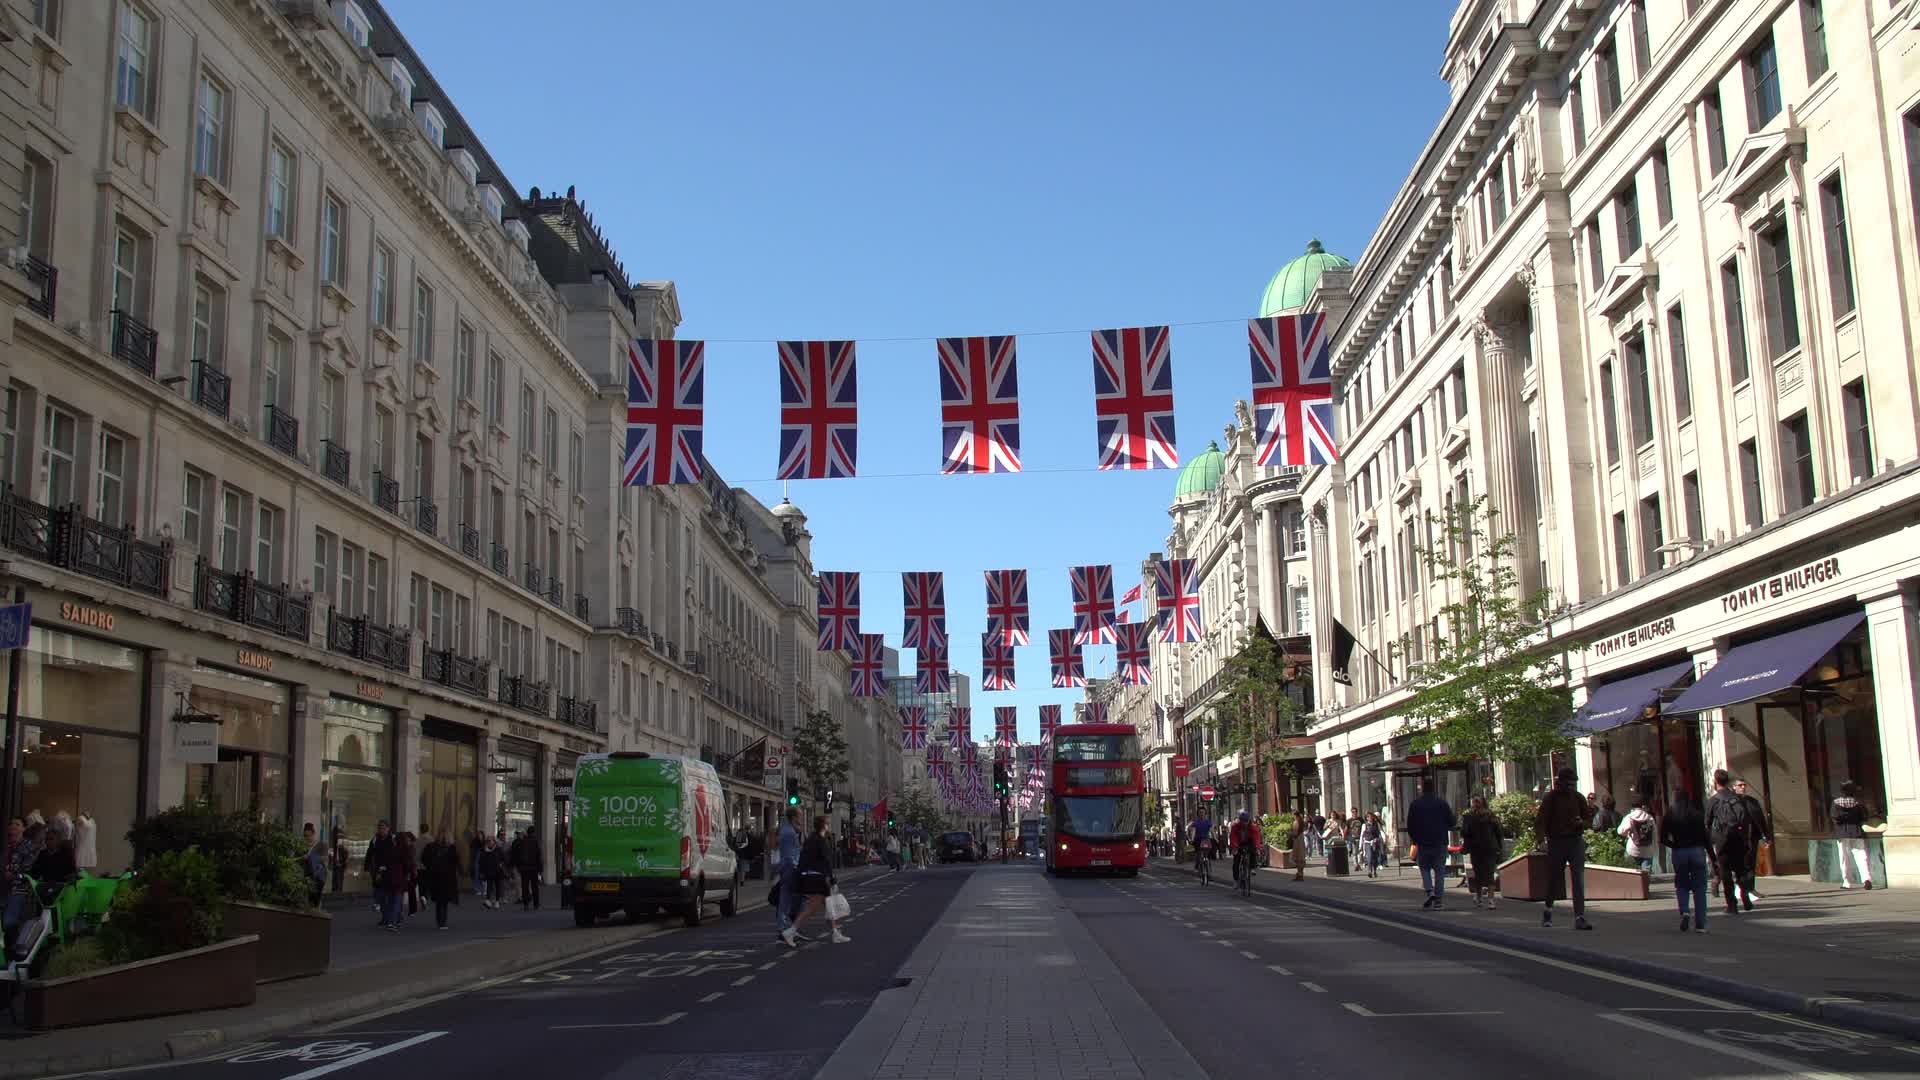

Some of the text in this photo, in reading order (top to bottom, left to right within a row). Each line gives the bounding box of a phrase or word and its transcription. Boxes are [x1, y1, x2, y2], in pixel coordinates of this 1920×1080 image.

[1721, 557, 1841, 614] TOMMY HILFIGER
[62, 601, 114, 631] SANDRO
[1595, 616, 1676, 657] TOMMY HILFIGER
[239, 650, 273, 672] SANDRO
[1333, 667, 1351, 681] alo
[357, 683, 385, 698] SANDRO
[1306, 785, 1320, 795] alo
[599, 795, 657, 813] 100%
[599, 814, 657, 827] electric
[520, 963, 753, 983] STOP
